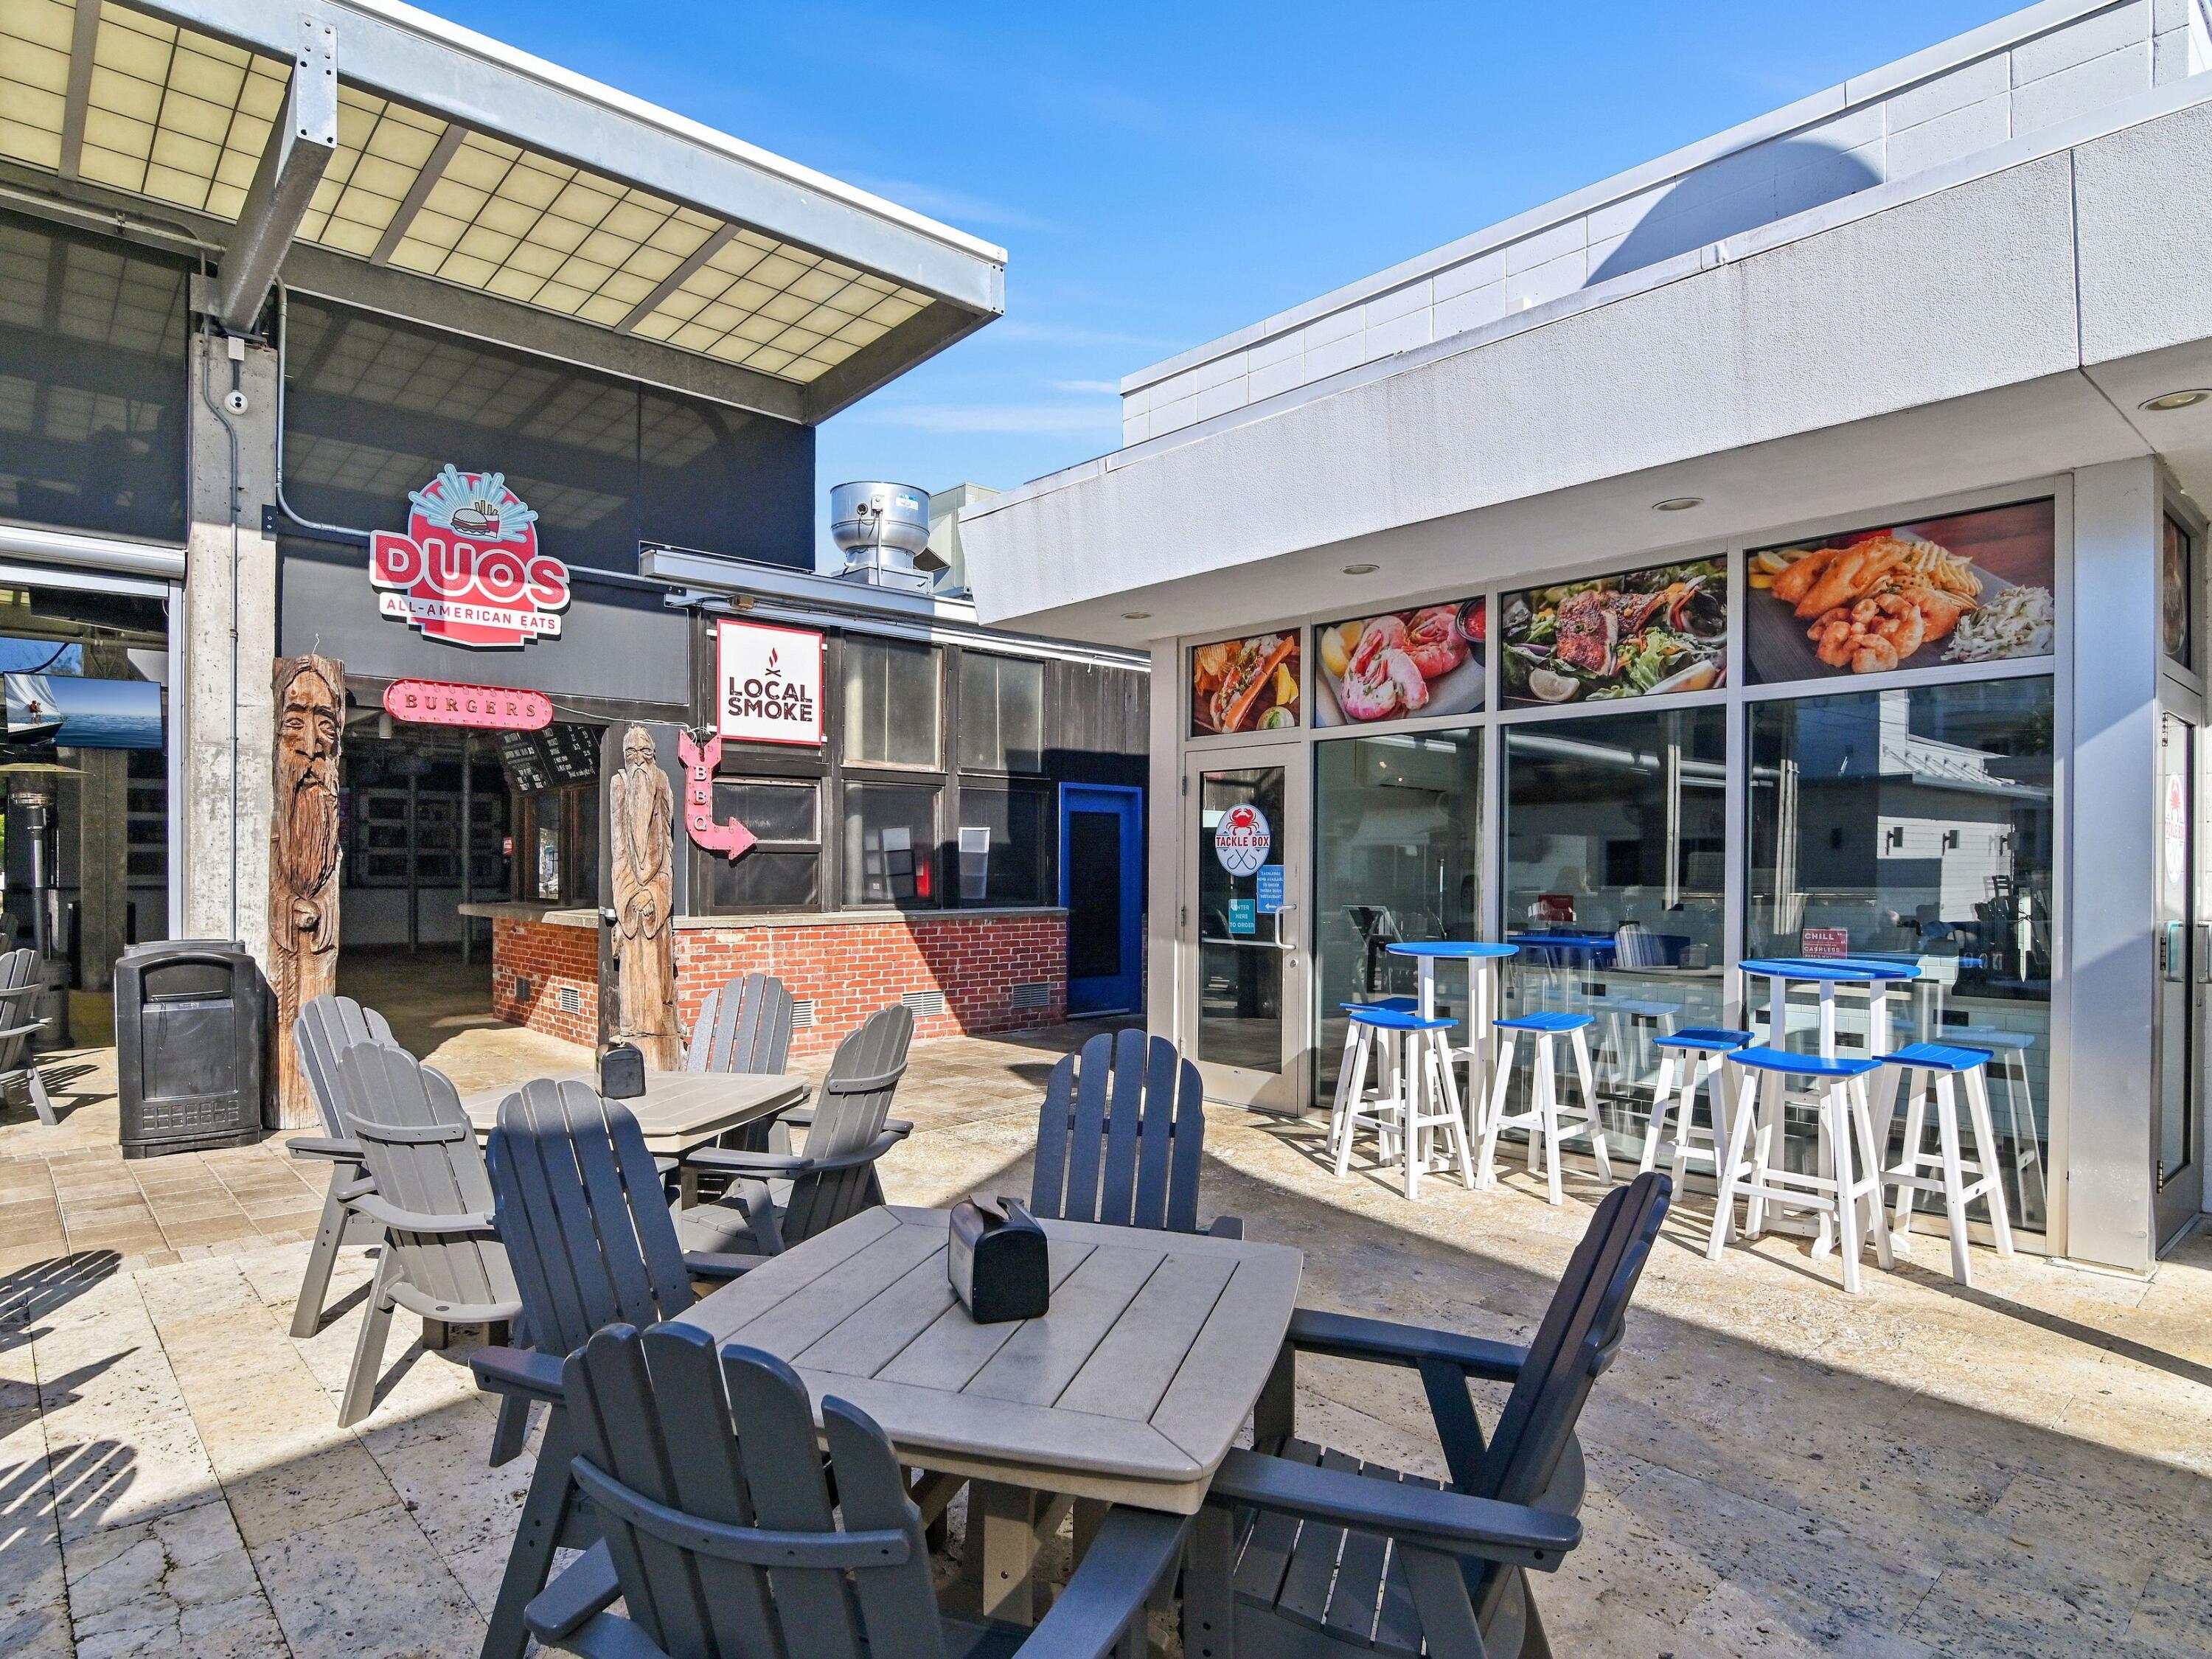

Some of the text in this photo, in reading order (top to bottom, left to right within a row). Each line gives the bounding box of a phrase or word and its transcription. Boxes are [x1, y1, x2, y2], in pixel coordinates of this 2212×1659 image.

[371, 531, 570, 608] DUOS
[386, 598, 556, 630] ALL-AMERICAN EATS
[728, 676, 813, 703] LOCAL
[404, 694, 537, 717] BURGERS
[728, 697, 813, 723] SMOKE
[693, 765, 708, 832] BBQ
[1216, 836, 1269, 846] TACKLE BOX
